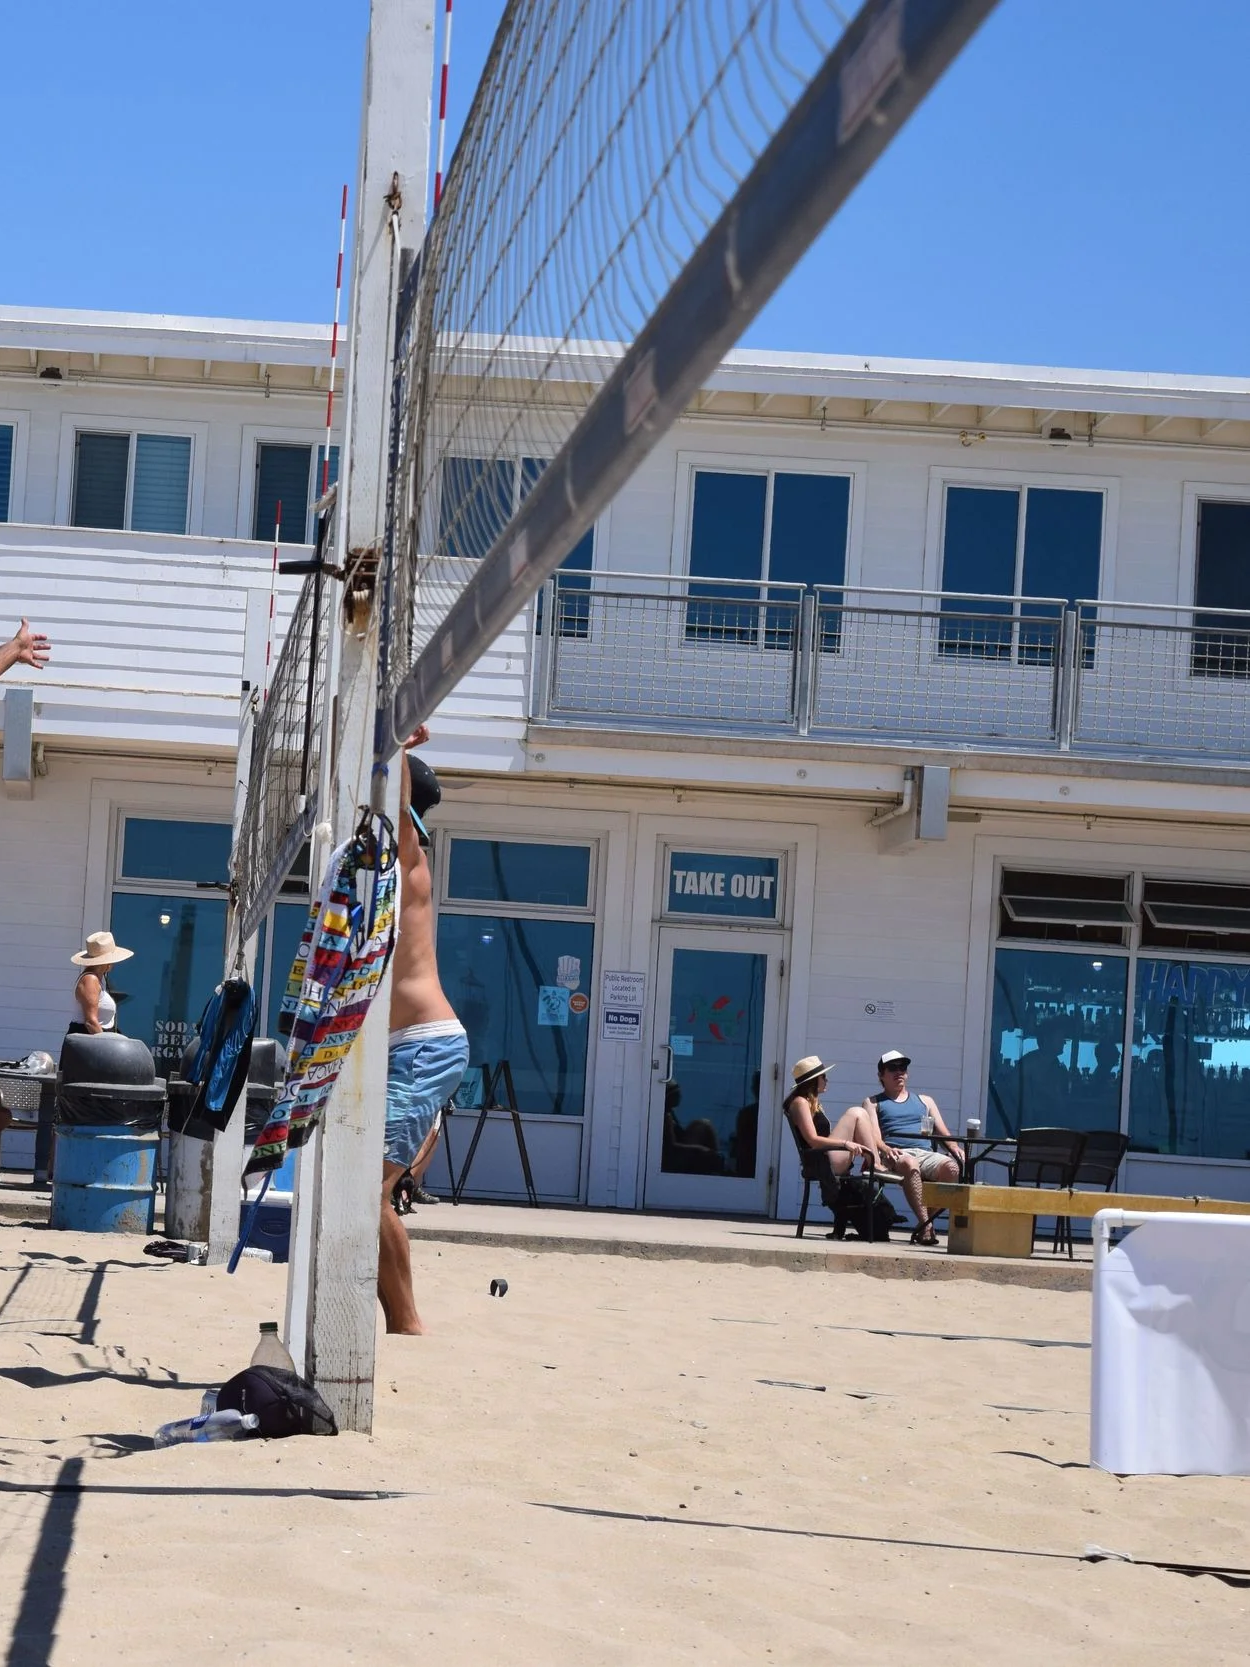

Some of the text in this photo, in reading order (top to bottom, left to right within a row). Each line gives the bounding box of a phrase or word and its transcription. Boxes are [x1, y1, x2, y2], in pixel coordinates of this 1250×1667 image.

[673, 870, 775, 899] TAKE OUT
[608, 1014, 637, 1024] No Dogs
